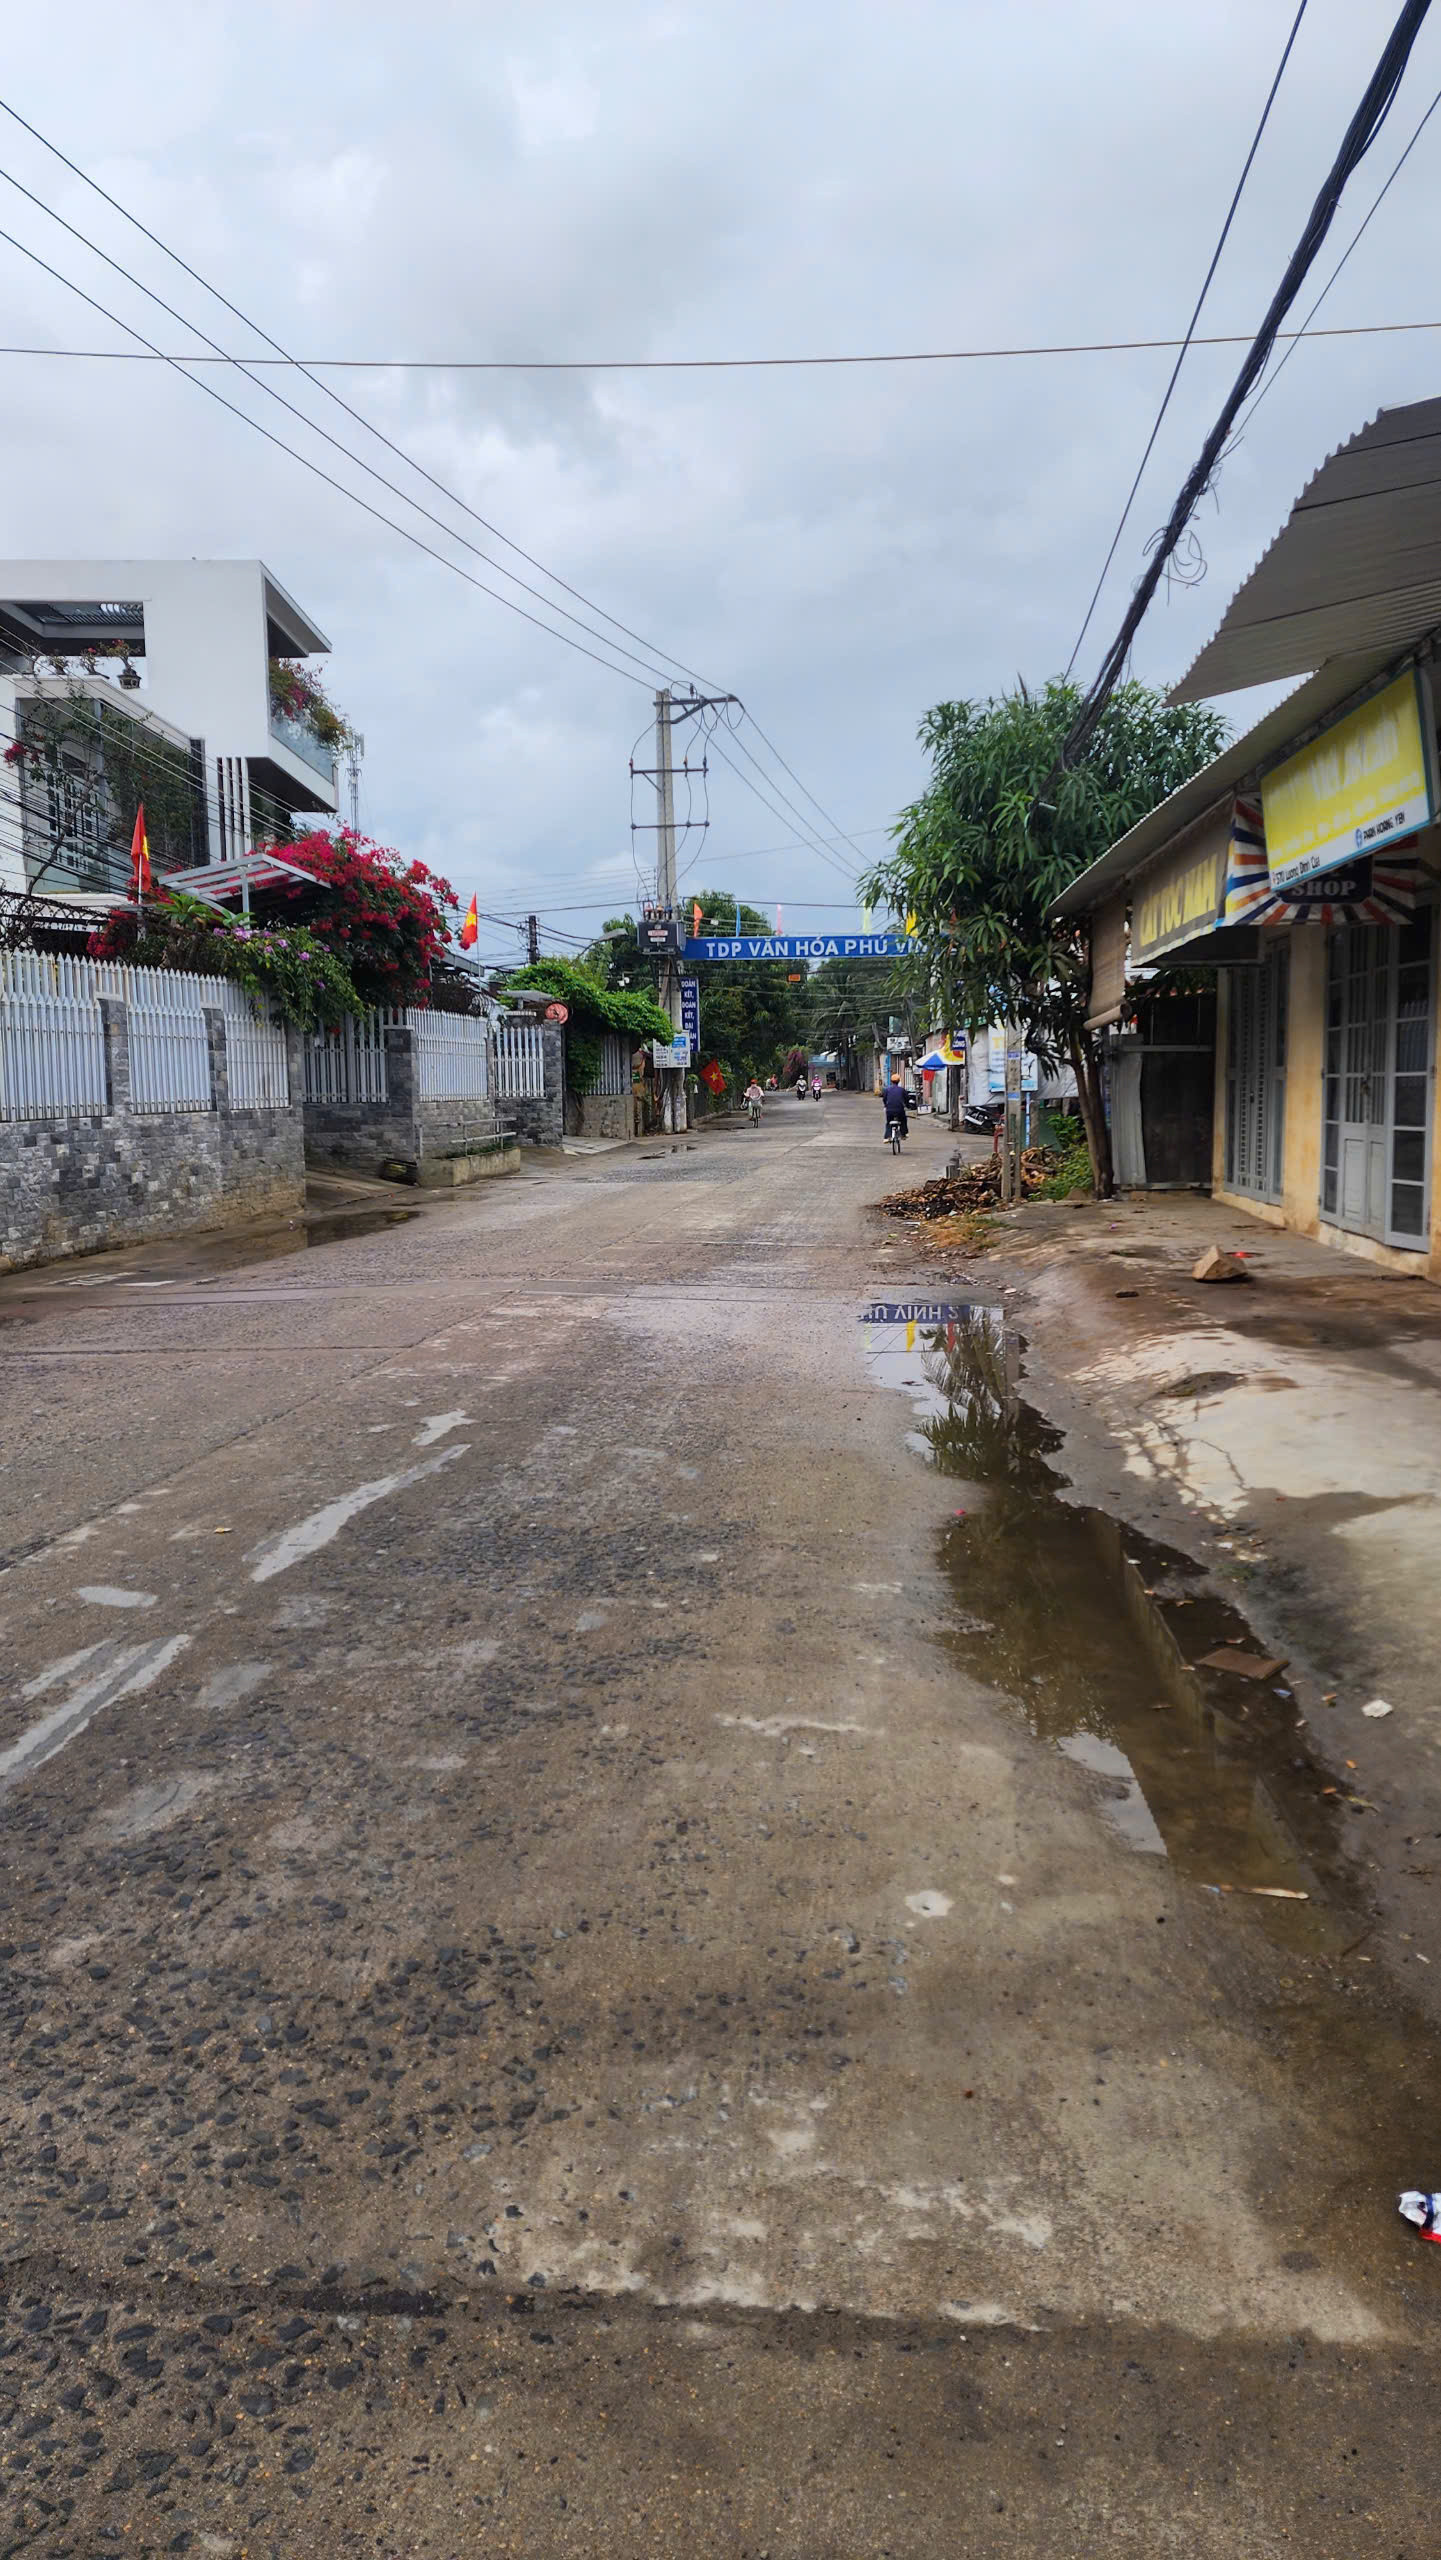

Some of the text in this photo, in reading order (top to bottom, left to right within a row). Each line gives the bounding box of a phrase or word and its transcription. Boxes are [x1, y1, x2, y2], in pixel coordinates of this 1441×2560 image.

[1291, 880, 1357, 897] SHOP
[706, 942, 742, 958] TDP
[748, 938, 789, 957] VĂN
[795, 936, 840, 957] HÓA
[844, 935, 889, 955] PHÚ
